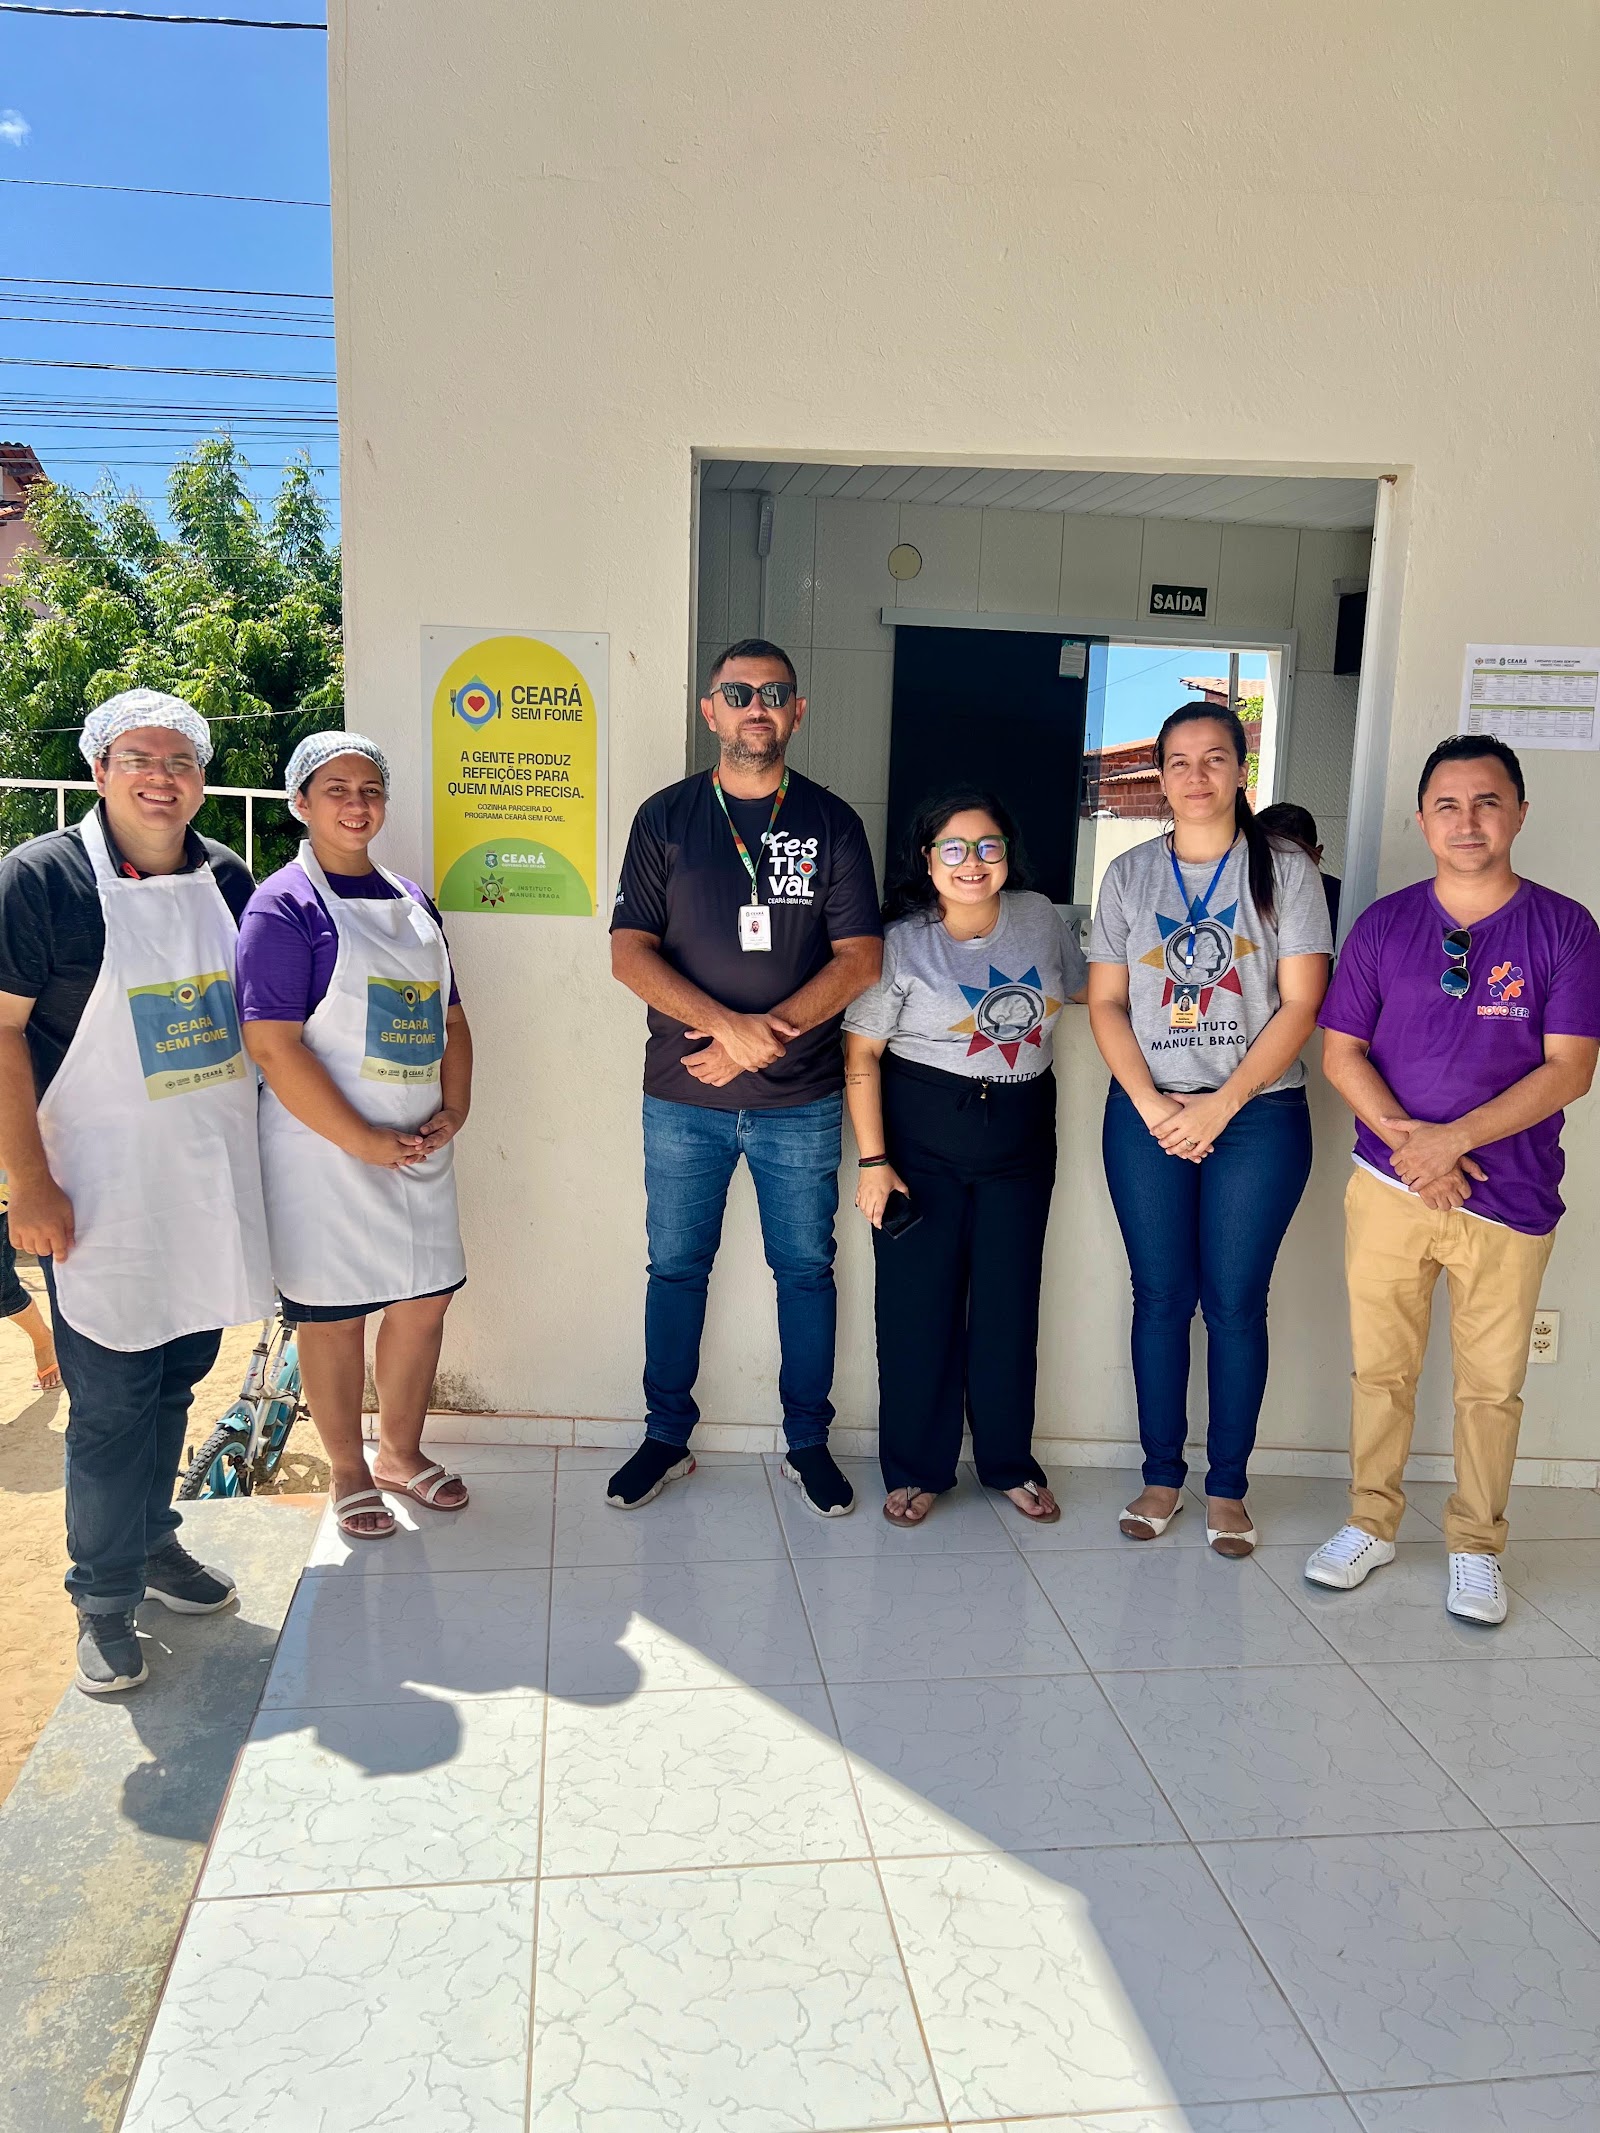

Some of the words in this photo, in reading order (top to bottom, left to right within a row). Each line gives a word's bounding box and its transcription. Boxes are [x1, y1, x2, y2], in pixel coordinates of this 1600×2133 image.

[1153, 591, 1203, 612] SAÍDA
[511, 683, 583, 707] CEARÁ
[511, 707, 541, 720] SEM
[544, 708, 583, 722] FOME
[460, 750, 470, 763] A
[472, 751, 515, 764] GENTE
[518, 752, 571, 766] PRODUZ
[462, 766, 532, 783] REFEIÇÕES
[535, 769, 569, 782] PARA
[447, 782, 487, 796] QUEM
[490, 783, 523, 797] MAIS
[526, 785, 585, 799] PRECISA.
[477, 803, 507, 811] COZINHA
[508, 804, 541, 812] PARCEIRA
[464, 812, 503, 820] PROGRAMA
[504, 812, 527, 821] CEARÁ
[544, 815, 565, 823] FOME.
[501, 852, 546, 865] CEARÁ
[769, 857, 795, 875] TI
[767, 896, 786, 905] CEARÁ
[786, 897, 799, 905] SEM
[799, 898, 813, 906] FOME
[1477, 1005, 1509, 1016] NOVO
[1510, 1006, 1530, 1018] SER
[167, 1015, 213, 1036] CEARÁ
[392, 1018, 429, 1030] CEARÁ
[155, 1037, 190, 1054] SEM
[193, 1028, 228, 1046] FOME
[380, 1031, 407, 1044] SEM
[409, 1033, 436, 1044] FOME
[1151, 1037, 1204, 1051] MANUEL
[1209, 1035, 1249, 1046] BRAG
[202, 1068, 223, 1079] CEARÁ
